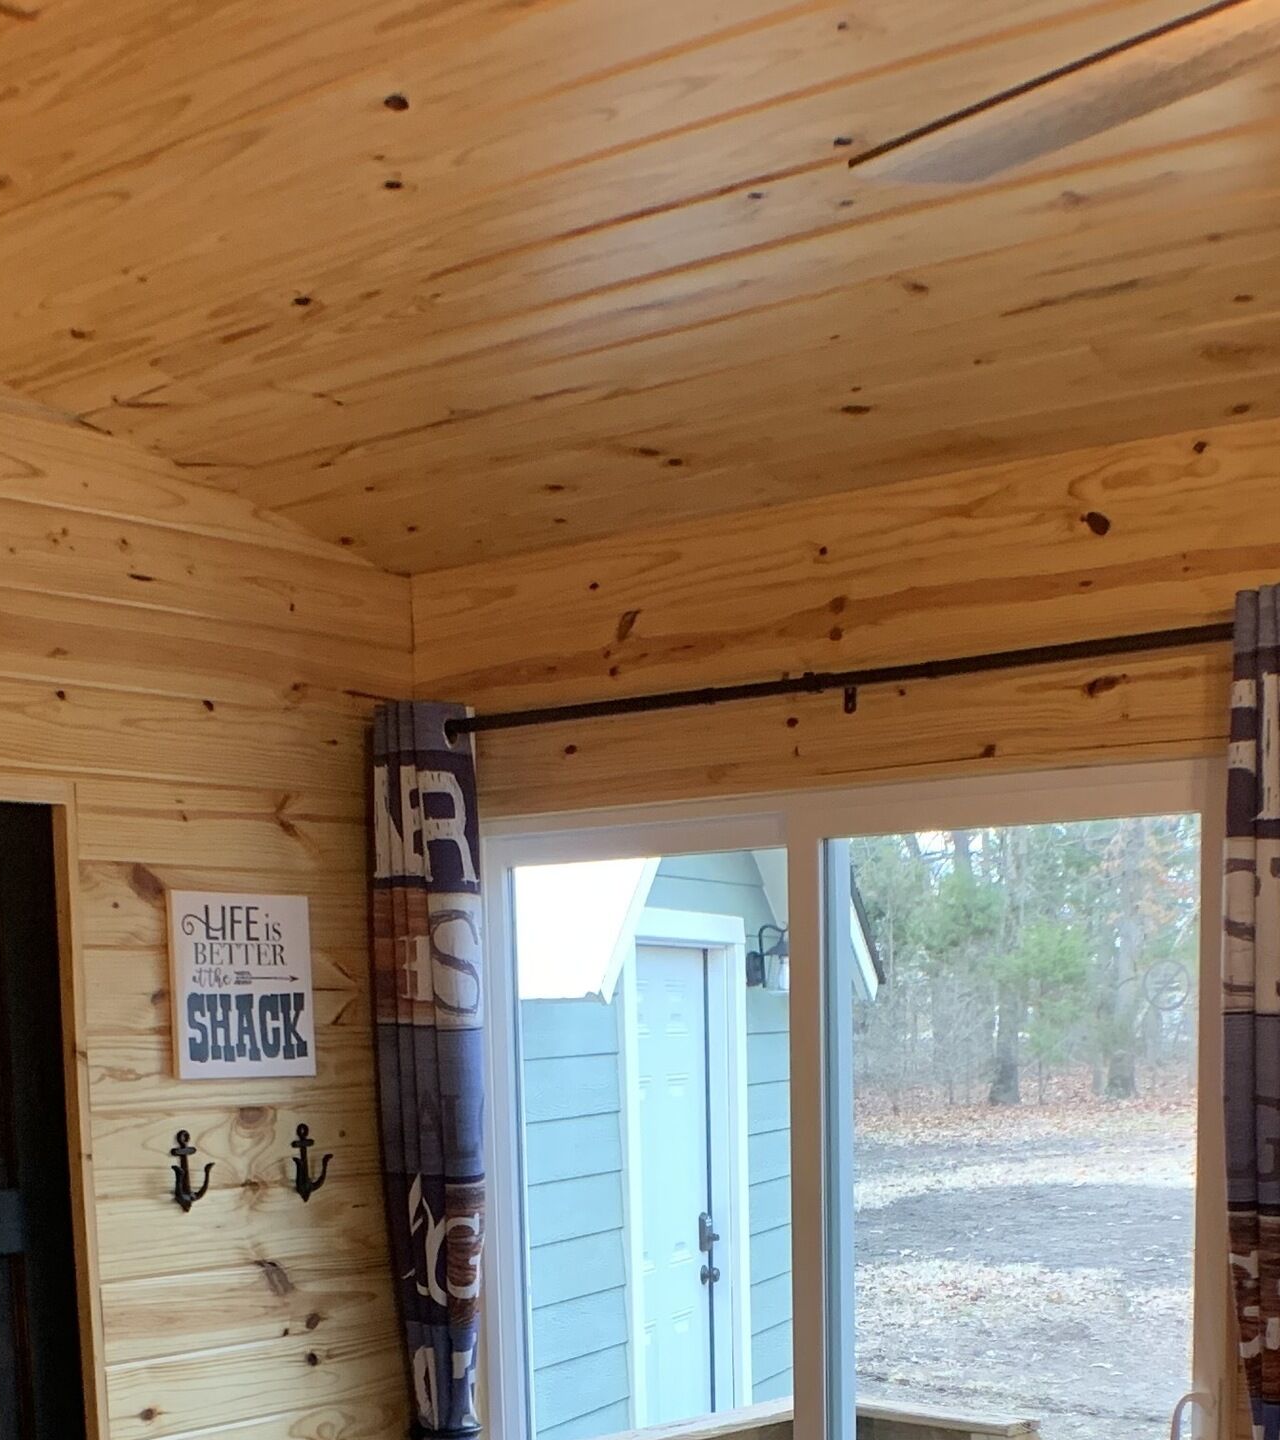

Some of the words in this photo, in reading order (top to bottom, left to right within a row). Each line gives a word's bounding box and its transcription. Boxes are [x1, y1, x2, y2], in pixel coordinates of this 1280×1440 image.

[181, 904, 260, 941] LIFE
[265, 914, 283, 942] is
[193, 942, 287, 967] BETTER
[186, 992, 309, 1063] SHACK
